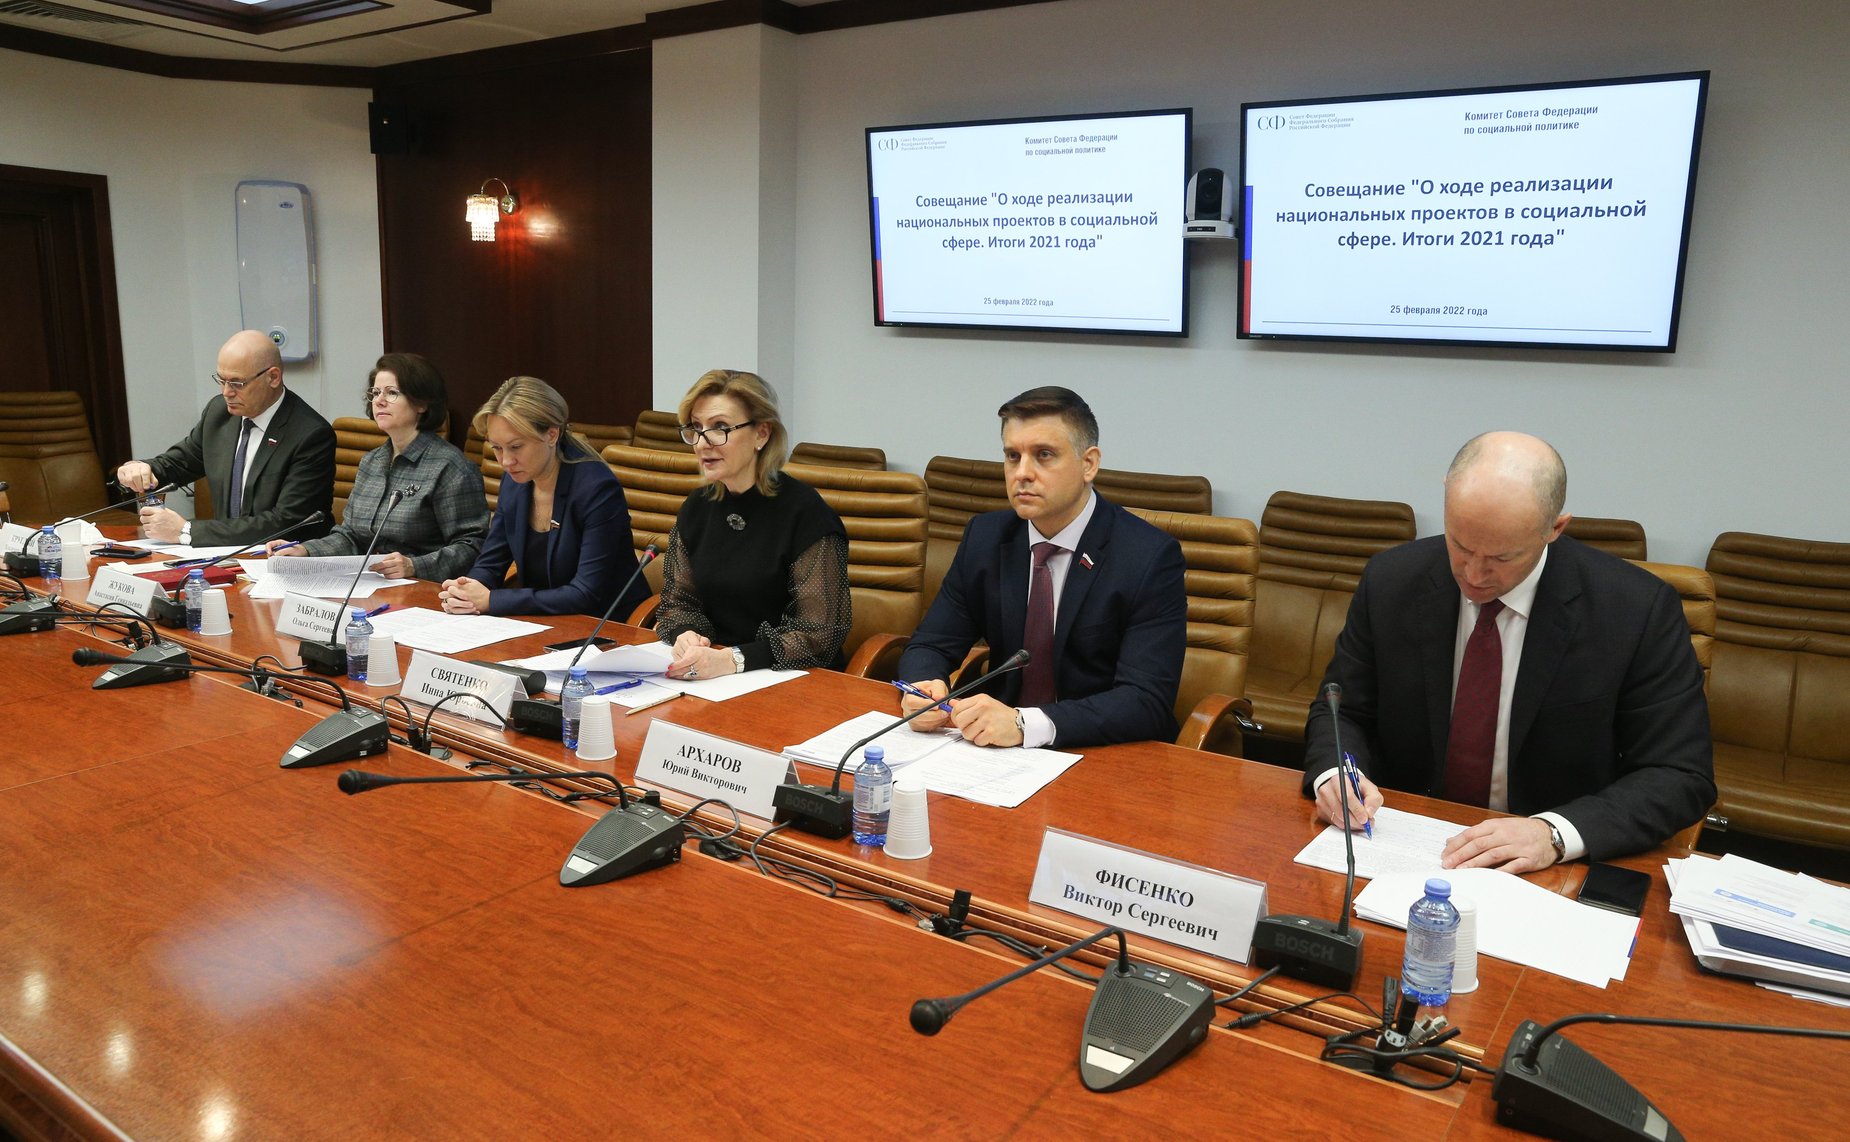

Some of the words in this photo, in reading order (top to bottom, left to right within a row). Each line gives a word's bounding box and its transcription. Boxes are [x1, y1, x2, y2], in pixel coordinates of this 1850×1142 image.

[1465, 112, 1503, 120] Комитет
[1506, 110, 1539, 118] Совета
[1542, 107, 1598, 117] Федерации
[1478, 123, 1532, 134] социальной
[1535, 122, 1579, 130] политике
[1079, 135, 1117, 143] Федерации
[1035, 148, 1073, 156] социальной
[1305, 184, 1405, 199] Совещание
[1412, 179, 1434, 194] "О
[1440, 182, 1484, 196] ходе
[1490, 178, 1612, 196] реализации
[916, 196, 987, 208] Совещание
[992, 193, 1007, 205] "О
[1012, 195, 1043, 207] ходе
[1048, 193, 1132, 207] реализации
[897, 218, 989, 230] национальных
[993, 217, 1054, 229] проектов
[1060, 217, 1066, 226] в
[1071, 212, 1157, 228] социальной
[1277, 210, 1405, 225] национальных
[1412, 208, 1498, 224] проектов
[1505, 208, 1514, 218] в
[1521, 200, 1646, 221] социальной
[943, 236, 984, 251] сфере.
[989, 236, 1025, 248] Итоги
[1030, 236, 1060, 248] 2021
[1066, 235, 1102, 250] года"
[1338, 232, 1395, 249] сфере.
[1403, 232, 1454, 245] Итоги
[1460, 231, 1504, 245] 2021
[1511, 229, 1564, 248] года"
[993, 298, 1020, 306] февраля
[1022, 298, 1037, 306] 2022
[1391, 305, 1400, 313] 25
[1403, 306, 1440, 315] февраля
[1443, 306, 1464, 315] 2022
[108, 580, 135, 595] ЖУКОВА
[296, 602, 337, 622] ЗАБРАЛОВ
[292, 617, 309, 628] Ольга
[309, 621, 334, 634] Сергеевн
[430, 667, 488, 691] СВЯТЕНКО
[421, 682, 444, 699] Инна
[676, 744, 743, 774] АРХАРОВ
[662, 759, 690, 775] Юрий
[690, 768, 748, 795] Викторович
[785, 793, 824, 815] BOSCH
[1095, 869, 1195, 909] ФИСЕНКО
[1062, 884, 1124, 917] Виктор
[1127, 902, 1219, 942] Сергеевич
[1274, 931, 1335, 961] BOSCH
